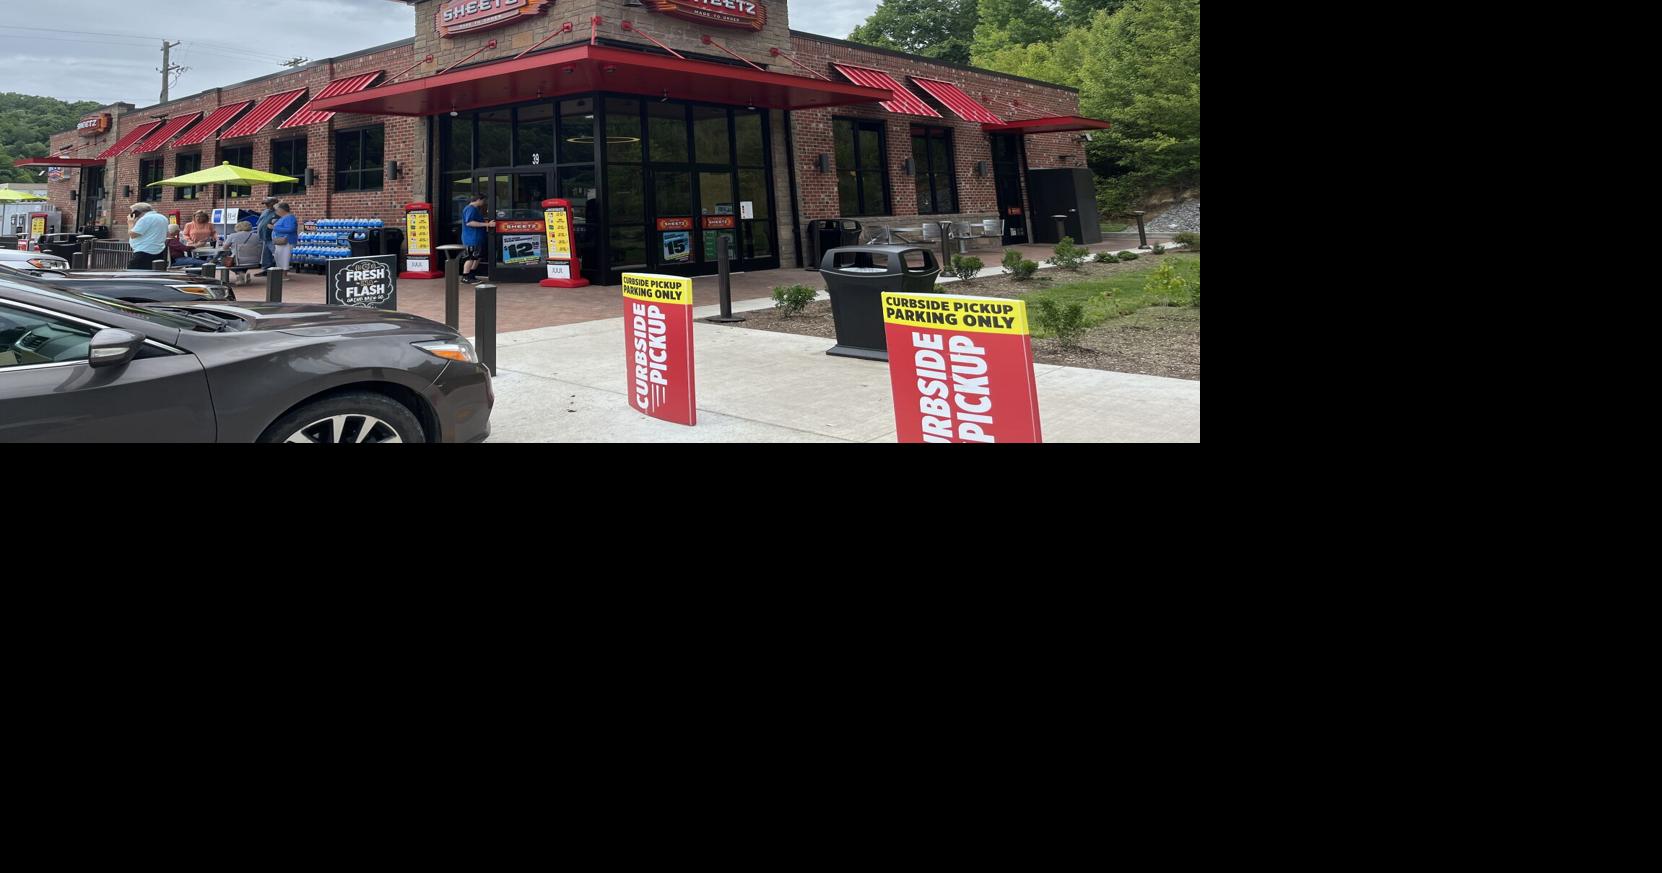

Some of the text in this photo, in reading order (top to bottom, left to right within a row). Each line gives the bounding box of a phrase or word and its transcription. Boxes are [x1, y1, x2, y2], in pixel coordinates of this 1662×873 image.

[531, 153, 540, 165] 39
[346, 268, 385, 282] FRESH
[623, 276, 682, 290] CURBSIDE PICKUP
[346, 283, 385, 298] FLASH
[623, 284, 682, 301] PARKING ONLY
[886, 296, 1013, 315] CURBSIDE PICKUP
[886, 307, 1015, 329] PARKING ONLY
[647, 304, 668, 386] PICKUP
[632, 302, 649, 410] CURBSIDE
[911, 331, 953, 443] RBSIDE
[948, 335, 995, 443] PICKUP
